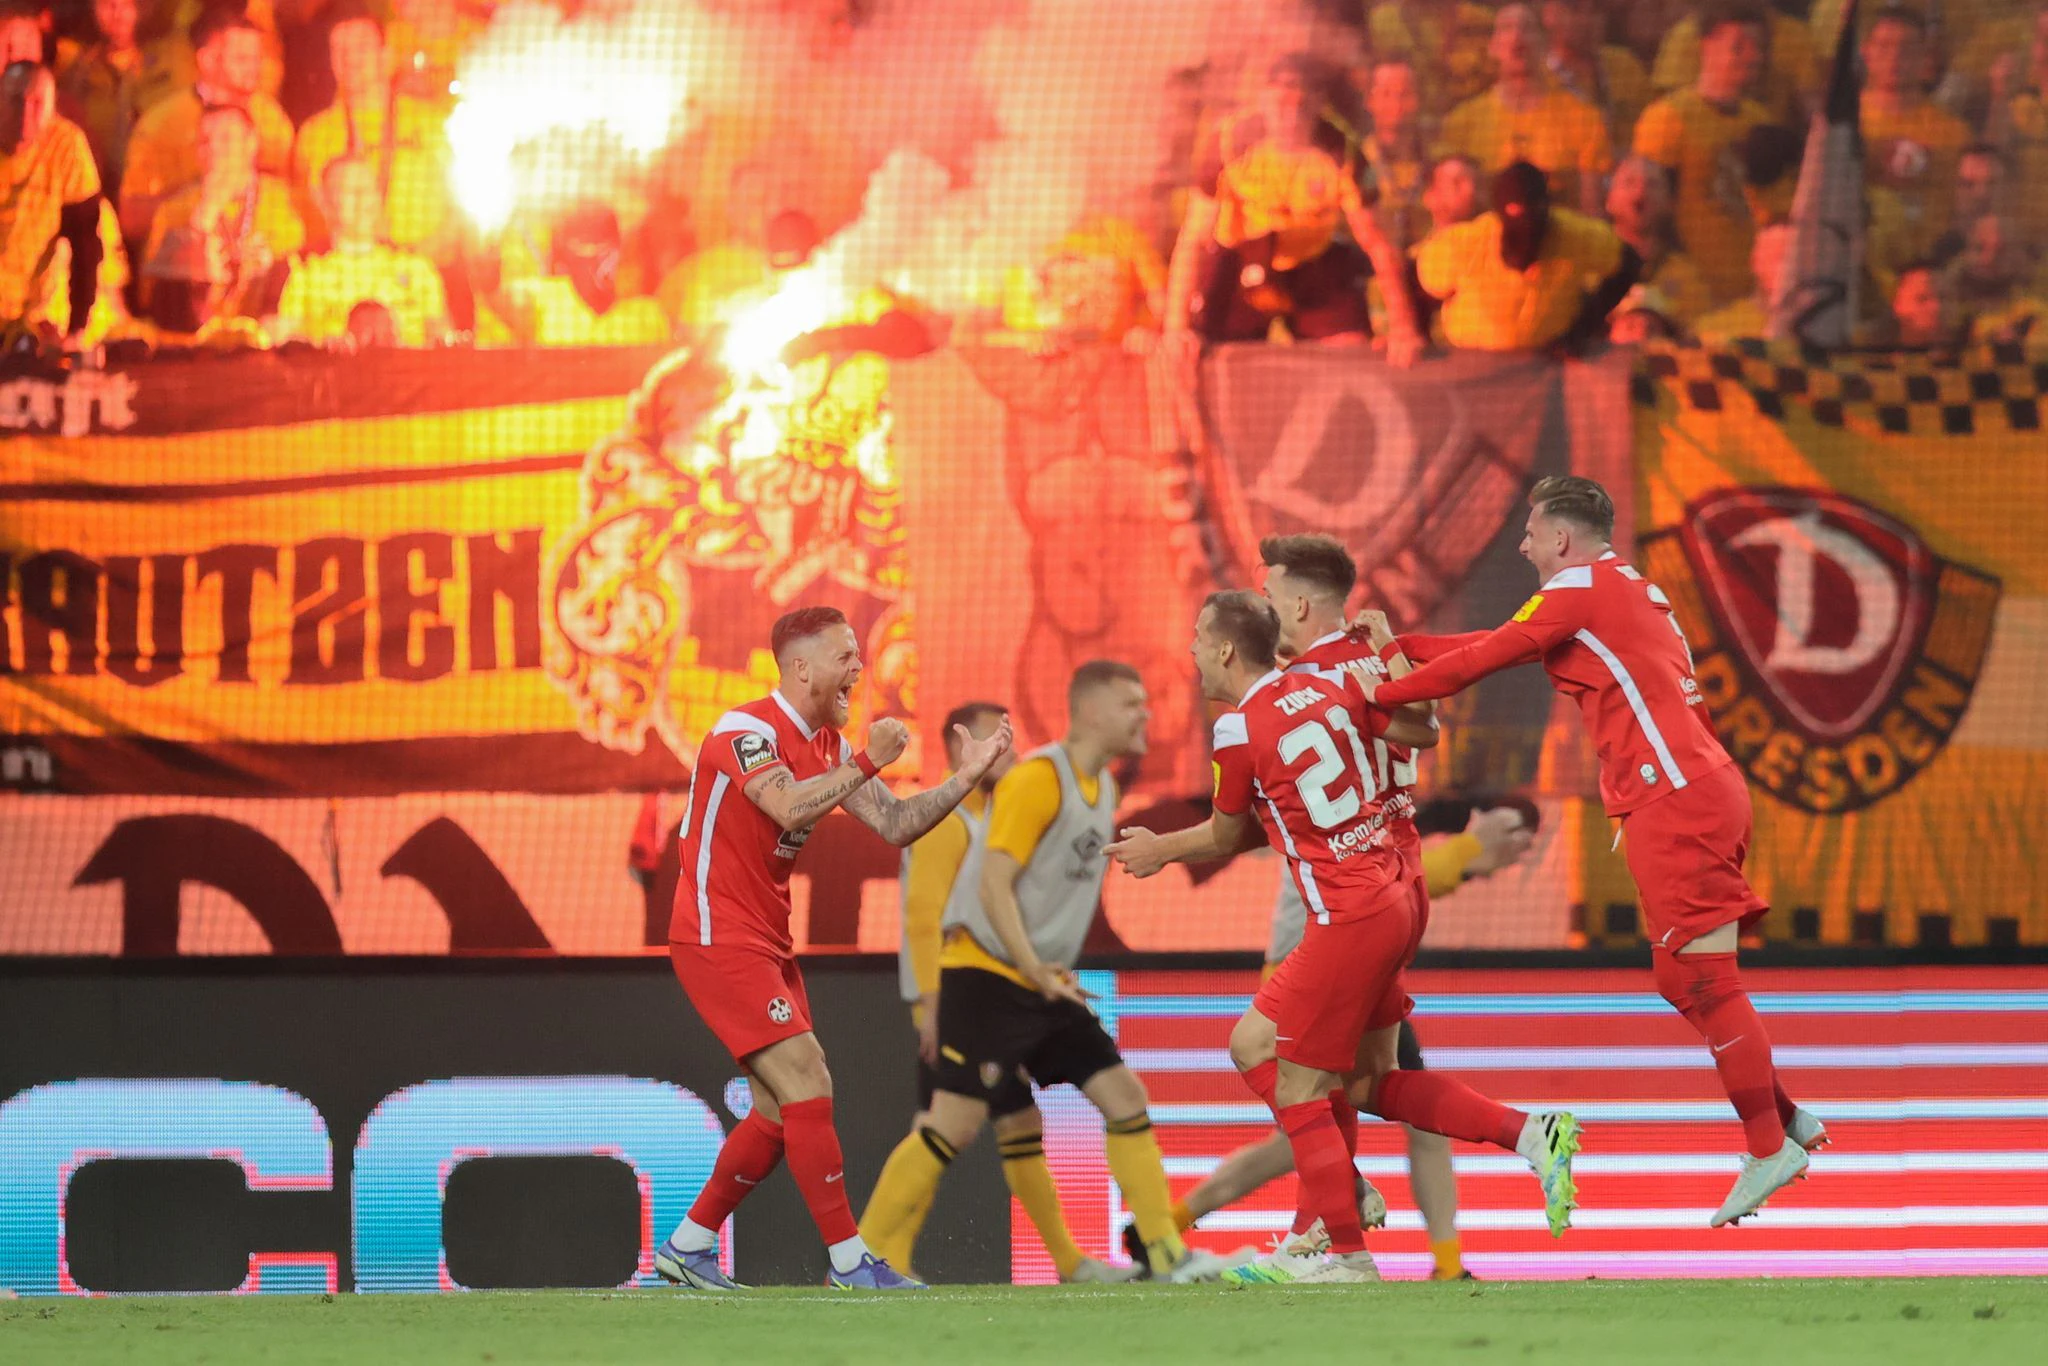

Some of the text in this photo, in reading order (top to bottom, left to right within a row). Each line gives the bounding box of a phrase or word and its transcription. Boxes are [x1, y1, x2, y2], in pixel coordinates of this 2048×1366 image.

[0, 527, 547, 689] AUTZEN
[1730, 512, 1898, 674] D
[1273, 686, 1327, 716] ZUCK
[1278, 704, 1376, 829] 21
[1698, 651, 1966, 807] DRESDEN
